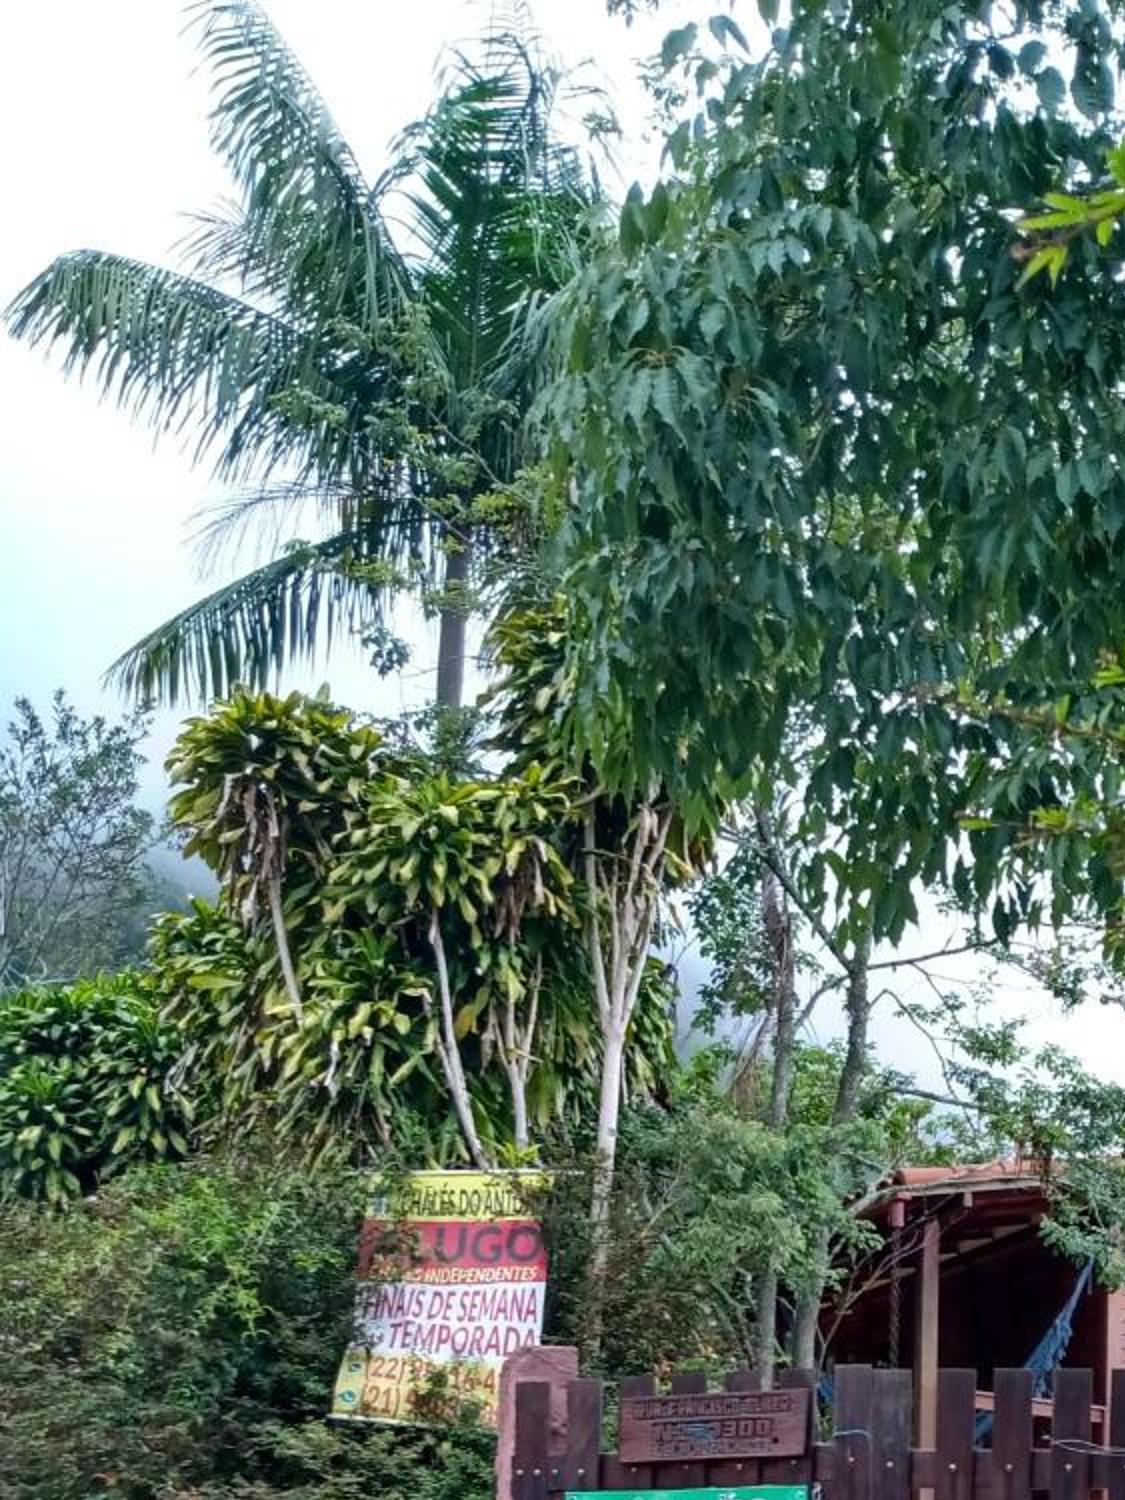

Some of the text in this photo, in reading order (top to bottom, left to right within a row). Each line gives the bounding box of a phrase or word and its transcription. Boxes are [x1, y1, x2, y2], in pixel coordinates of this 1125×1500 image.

[460, 1190, 481, 1215] DO
[424, 1266, 537, 1283] INDEPENDENTES
[428, 1289, 456, 1321] DE
[457, 1287, 537, 1323] SEMANA
[389, 1320, 535, 1359] TEMPORADA
[366, 1355, 404, 1384] (22)
[721, 1418, 772, 1438] 300
